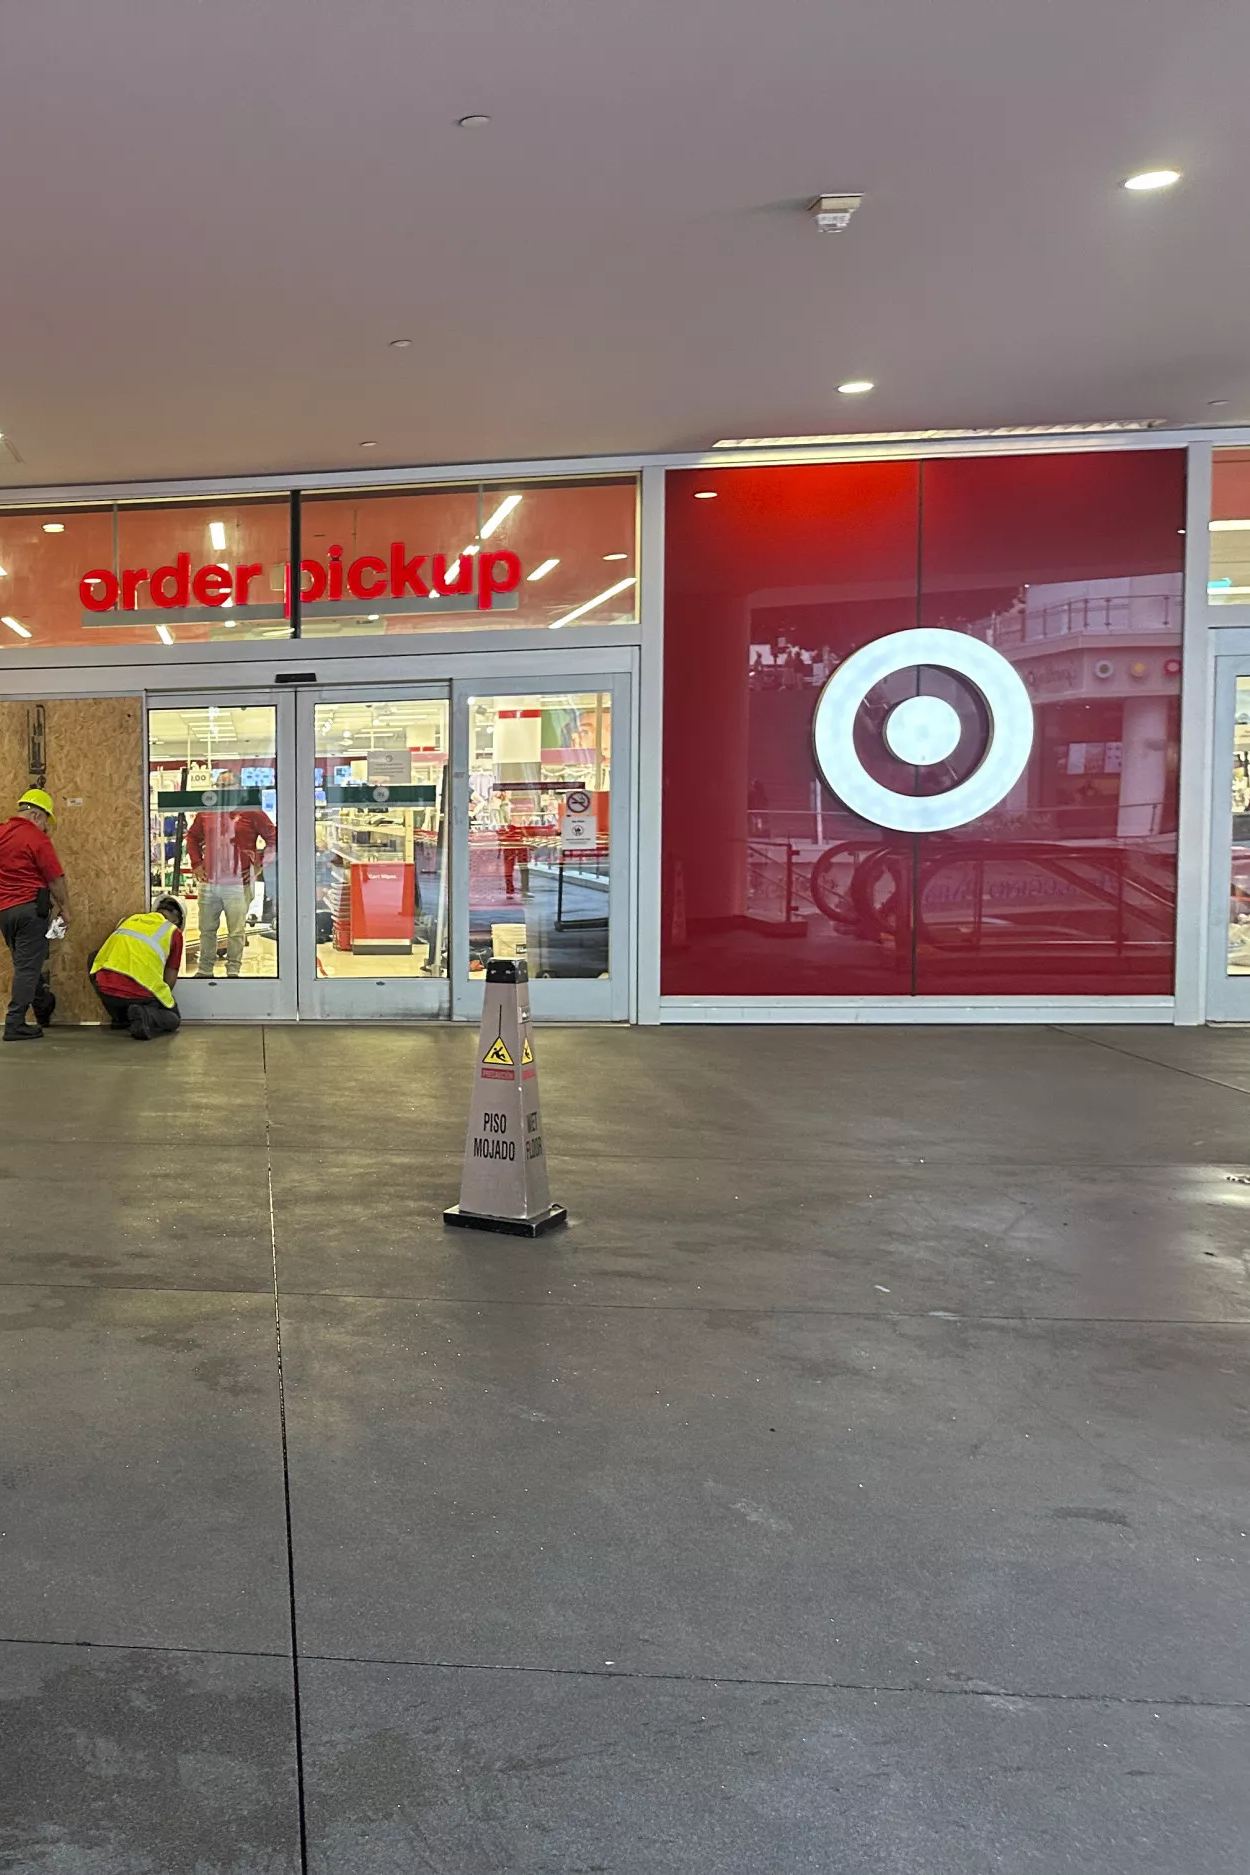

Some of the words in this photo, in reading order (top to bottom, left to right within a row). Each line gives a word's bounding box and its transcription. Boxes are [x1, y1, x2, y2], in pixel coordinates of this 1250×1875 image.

[79, 552, 263, 612] order
[284, 542, 522, 619] pickup
[483, 1112, 507, 1134] PISO
[473, 1137, 516, 1161] MOJADO
